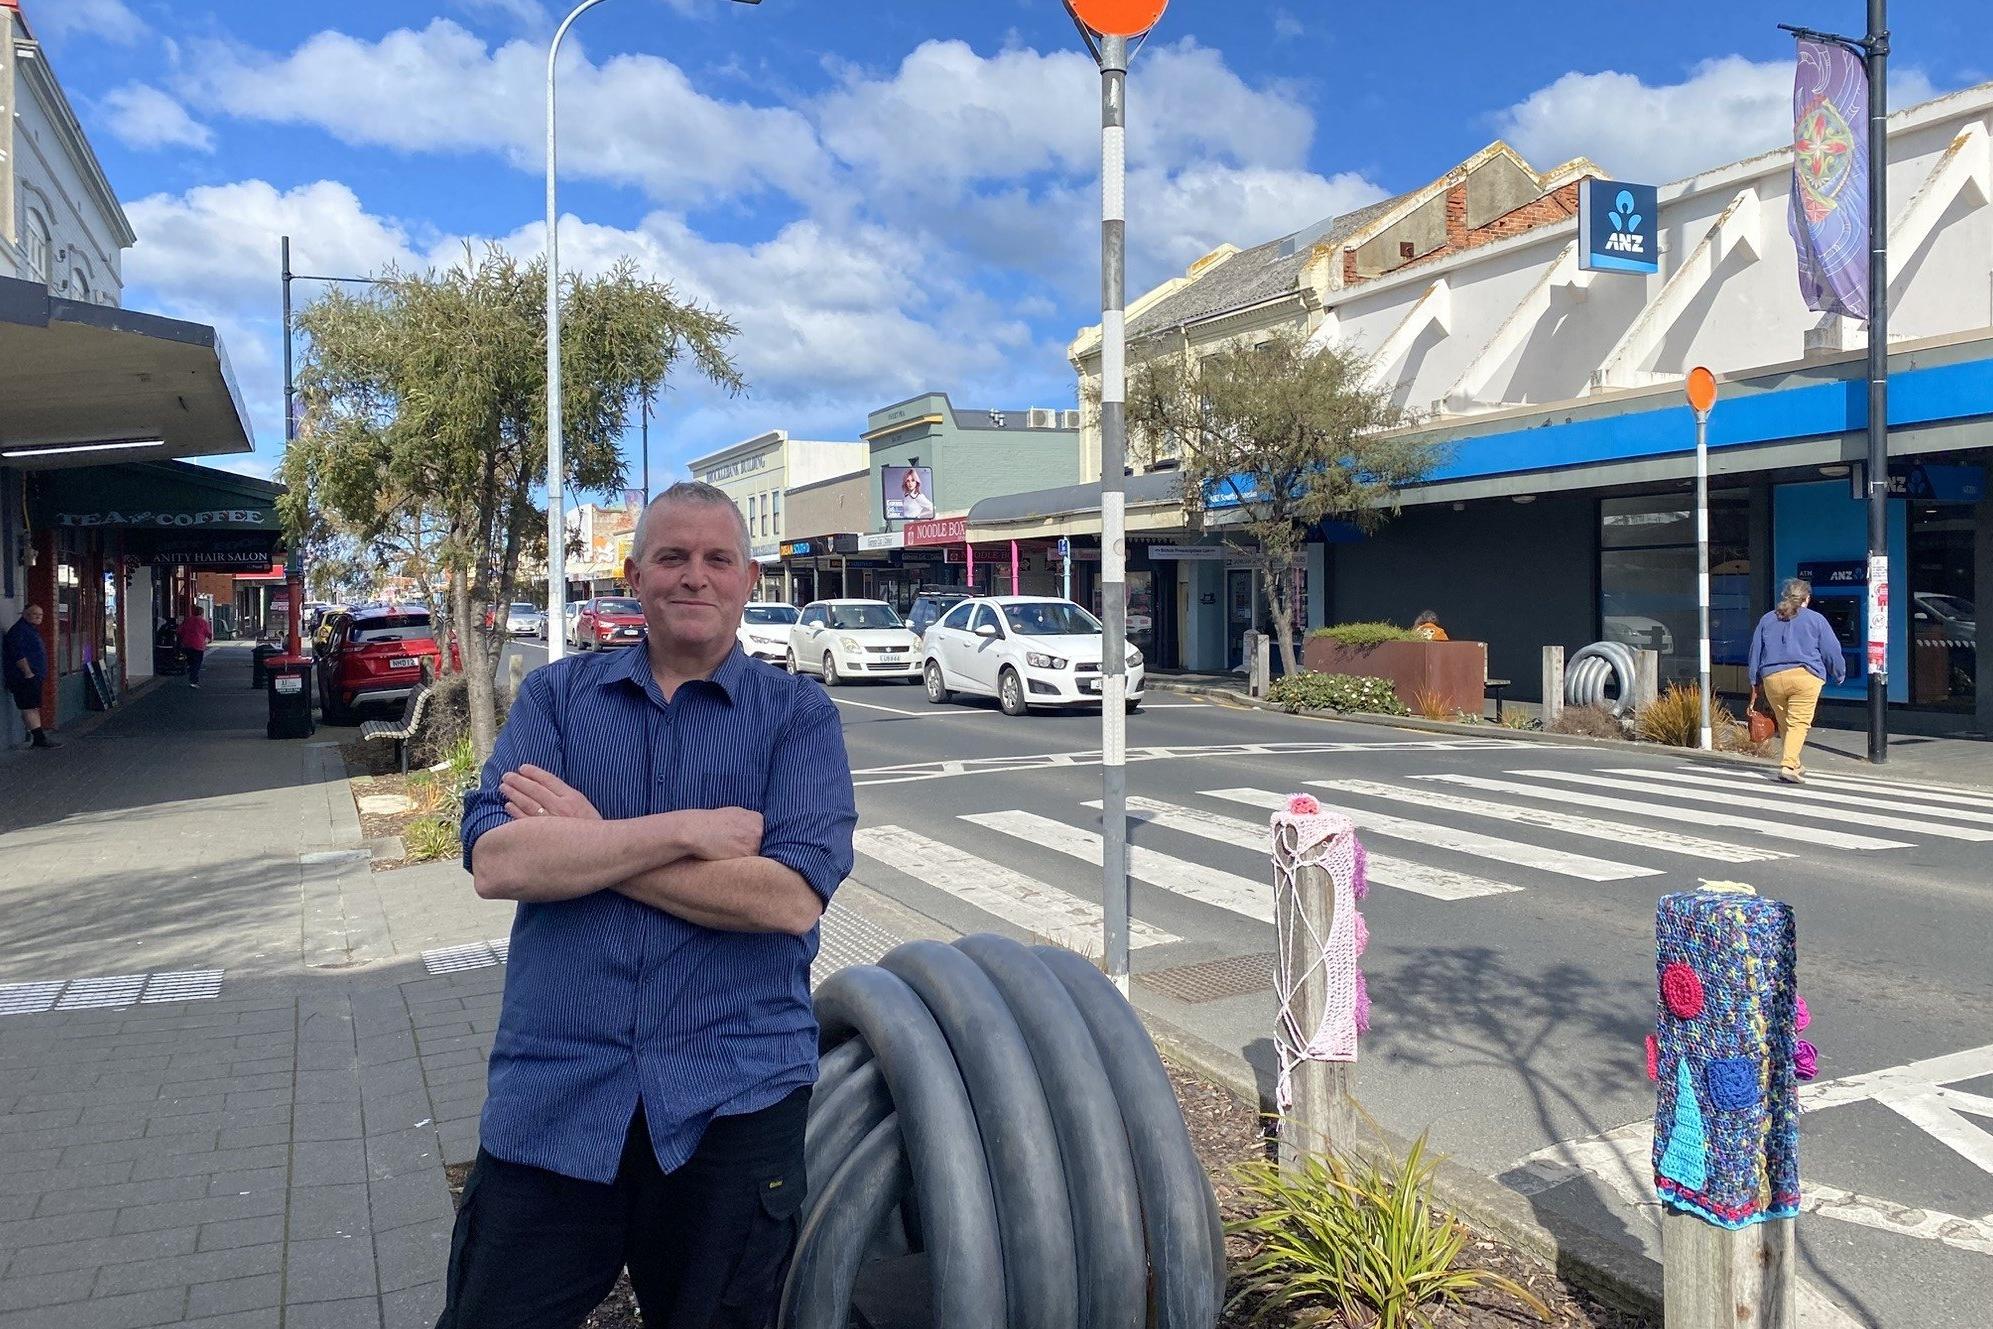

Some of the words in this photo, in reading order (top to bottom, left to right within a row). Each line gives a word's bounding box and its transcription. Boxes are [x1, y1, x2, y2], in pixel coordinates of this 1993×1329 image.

[1605, 232, 1644, 253] ANZ
[741, 454, 766, 474] BUILDING
[1887, 476, 1906, 493] NZ
[57, 510, 128, 527] TEA
[155, 509, 265, 527] COFFEE
[917, 523, 948, 539] NOODLE
[948, 520, 966, 536] BOX
[194, 553, 225, 563] HAIR
[227, 552, 268, 562] SALON
[961, 551, 998, 560] NODLE
[1830, 570, 1853, 581] ANZ
